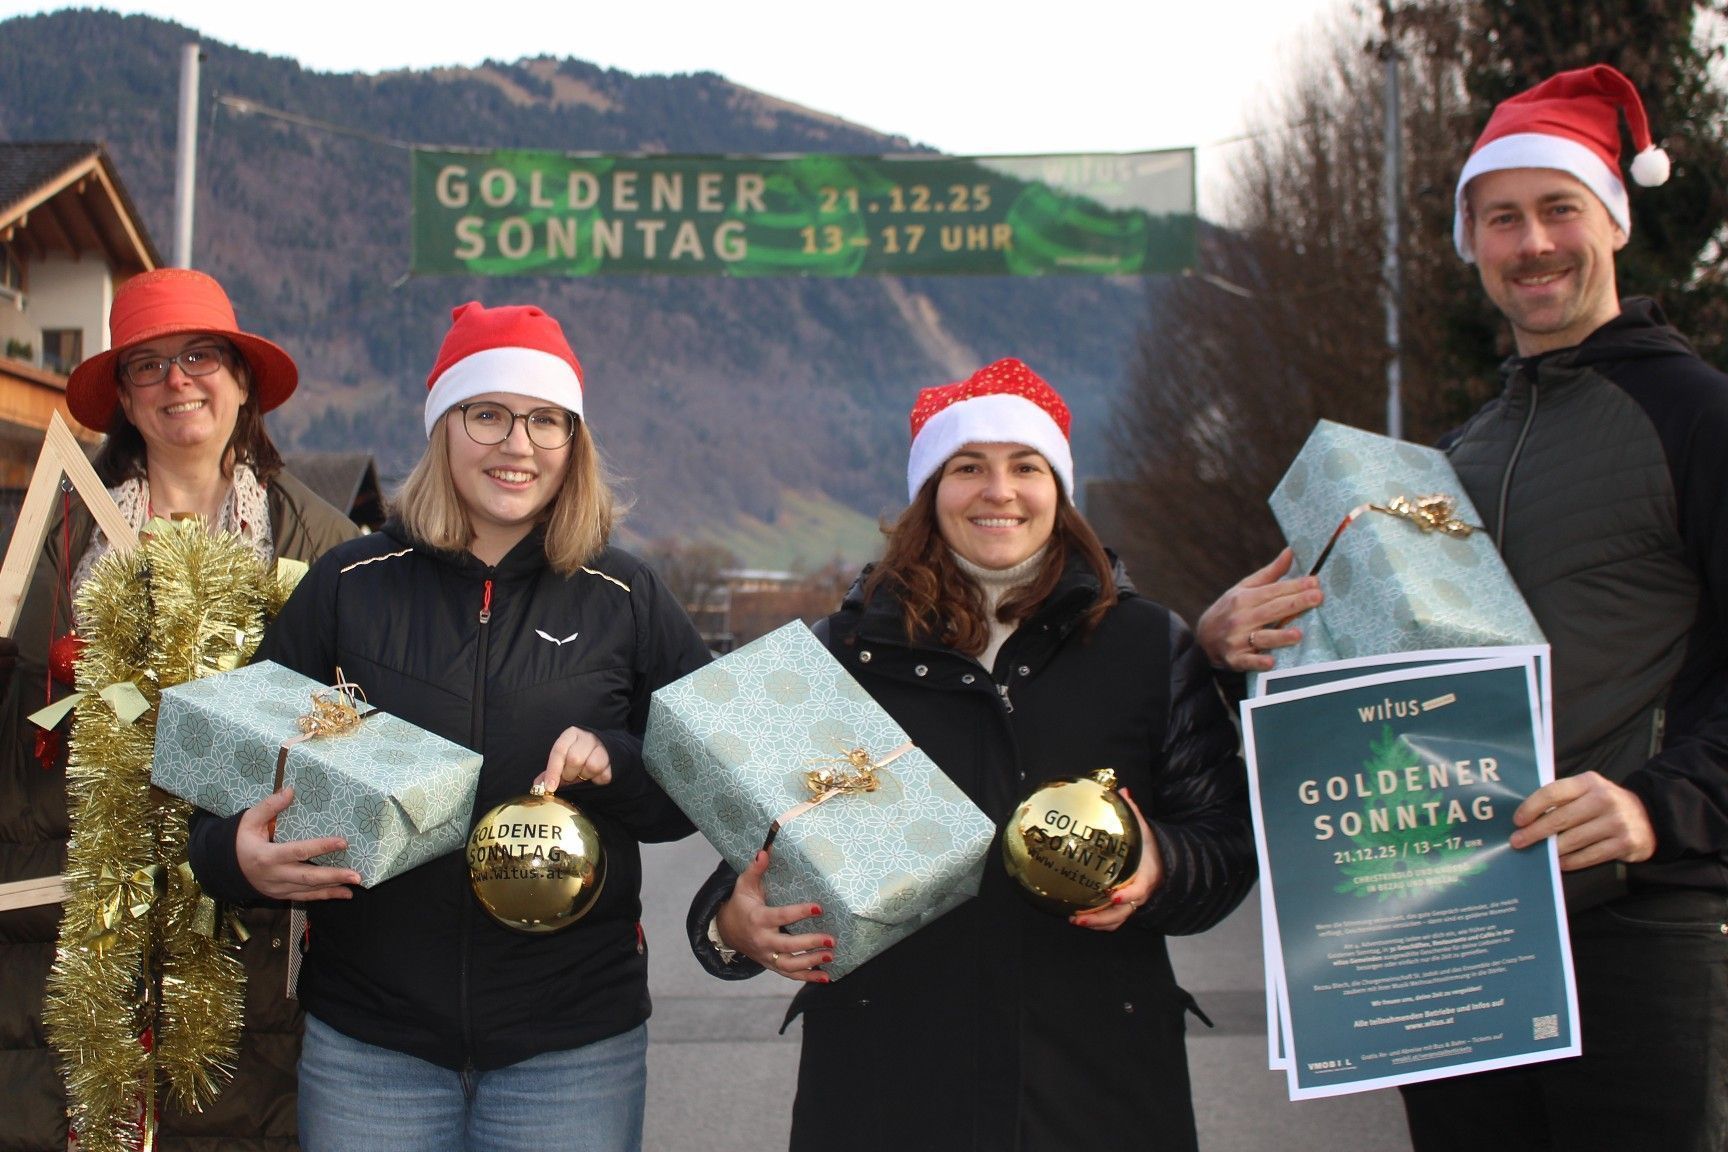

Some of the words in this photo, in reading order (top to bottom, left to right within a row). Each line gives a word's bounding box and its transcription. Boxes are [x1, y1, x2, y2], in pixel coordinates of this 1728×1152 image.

[435, 164, 767, 213] GOLDENER
[818, 184, 993, 214] 21.12.25
[454, 216, 749, 262] SONNTAG
[881, 225, 926, 254] 17
[940, 223, 1014, 252] UHR
[1357, 697, 1420, 723] witus
[1298, 757, 1501, 805] GOLDENER
[472, 823, 562, 844] GOLDENER
[1044, 809, 1130, 858] GOLDENE
[1313, 796, 1495, 841] SONNTAG
[469, 844, 561, 865] SONNTAG
[1035, 828, 1118, 879] SONNTA
[1333, 845, 1397, 865] 21.12.25
